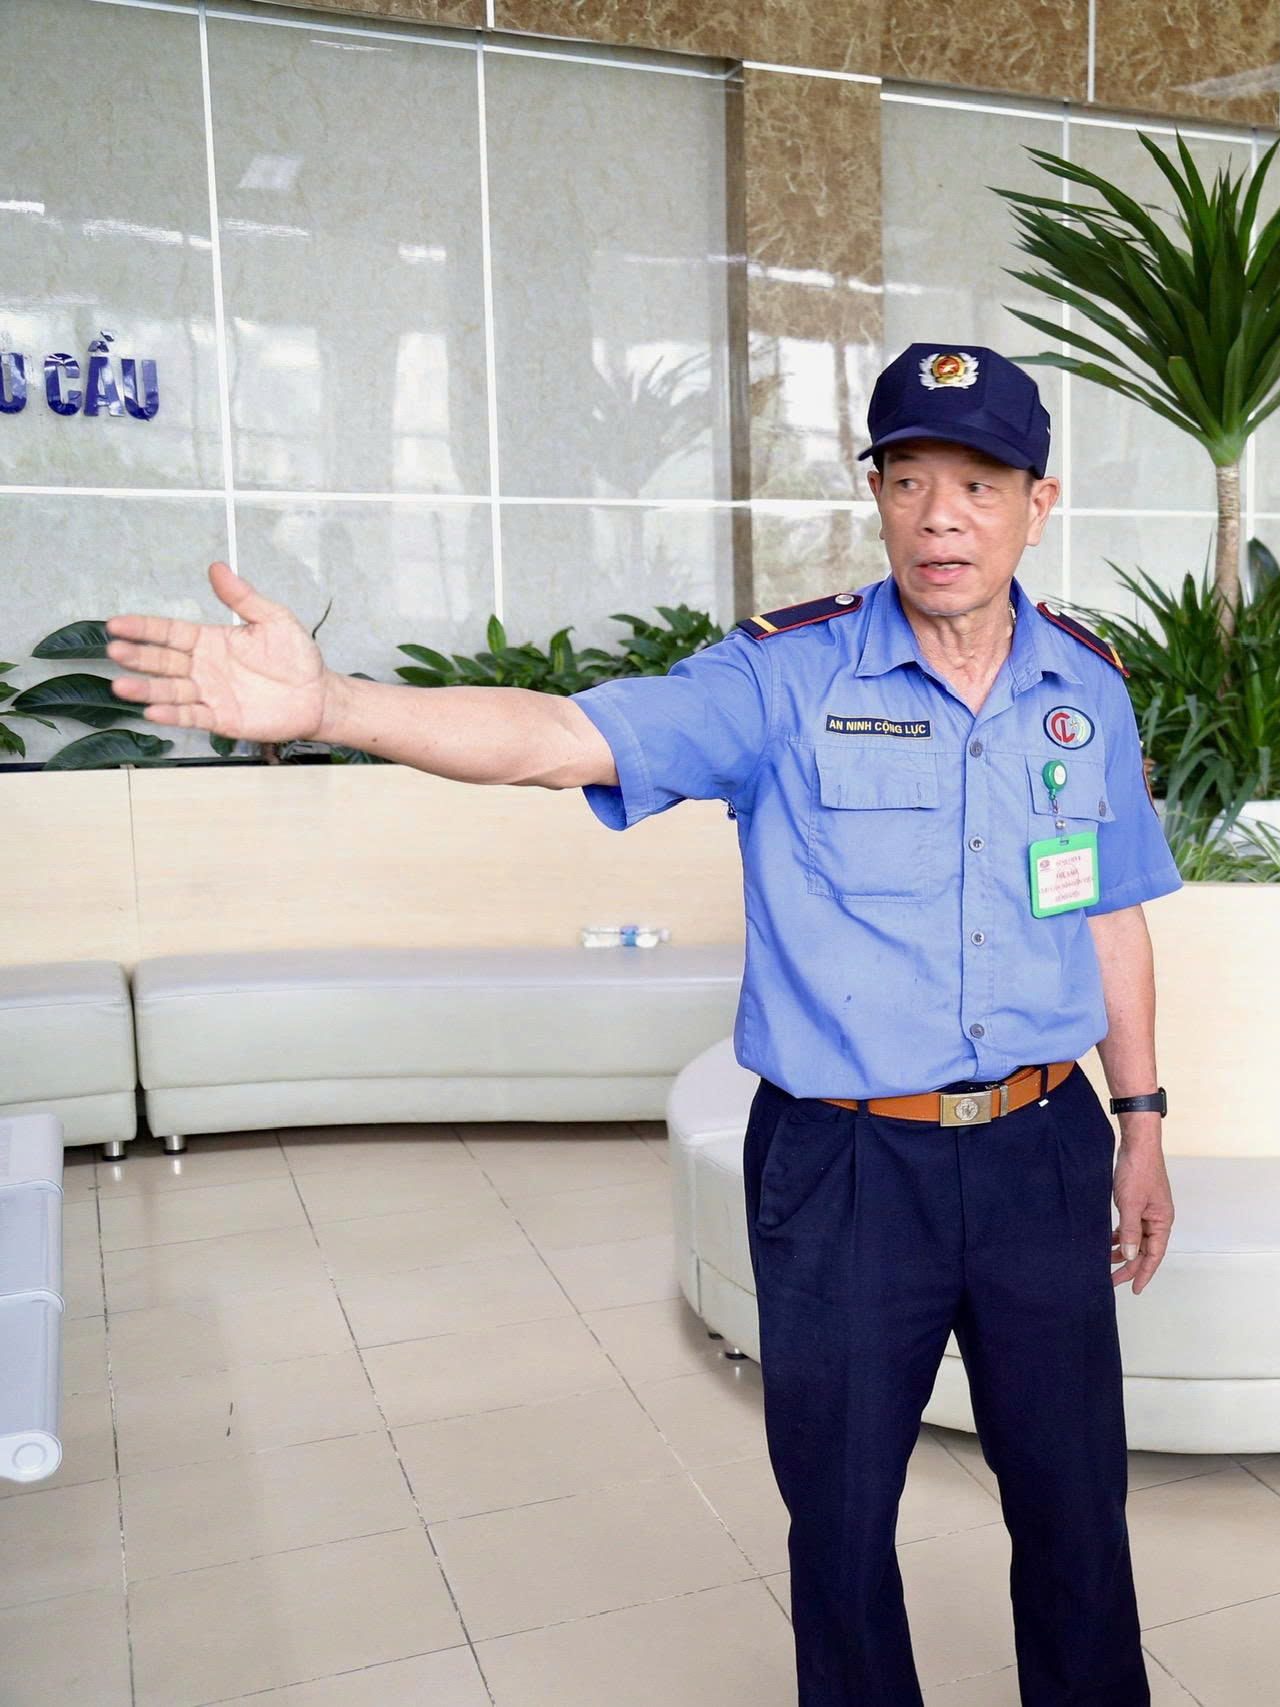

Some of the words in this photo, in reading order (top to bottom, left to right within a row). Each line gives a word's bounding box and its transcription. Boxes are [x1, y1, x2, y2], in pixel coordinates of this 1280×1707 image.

[44, 330, 160, 420] CẦU
[829, 719, 843, 731] AN
[846, 720, 872, 731] NINH
[874, 720, 902, 735] CỘNG
[905, 724, 926, 737] LỰC
